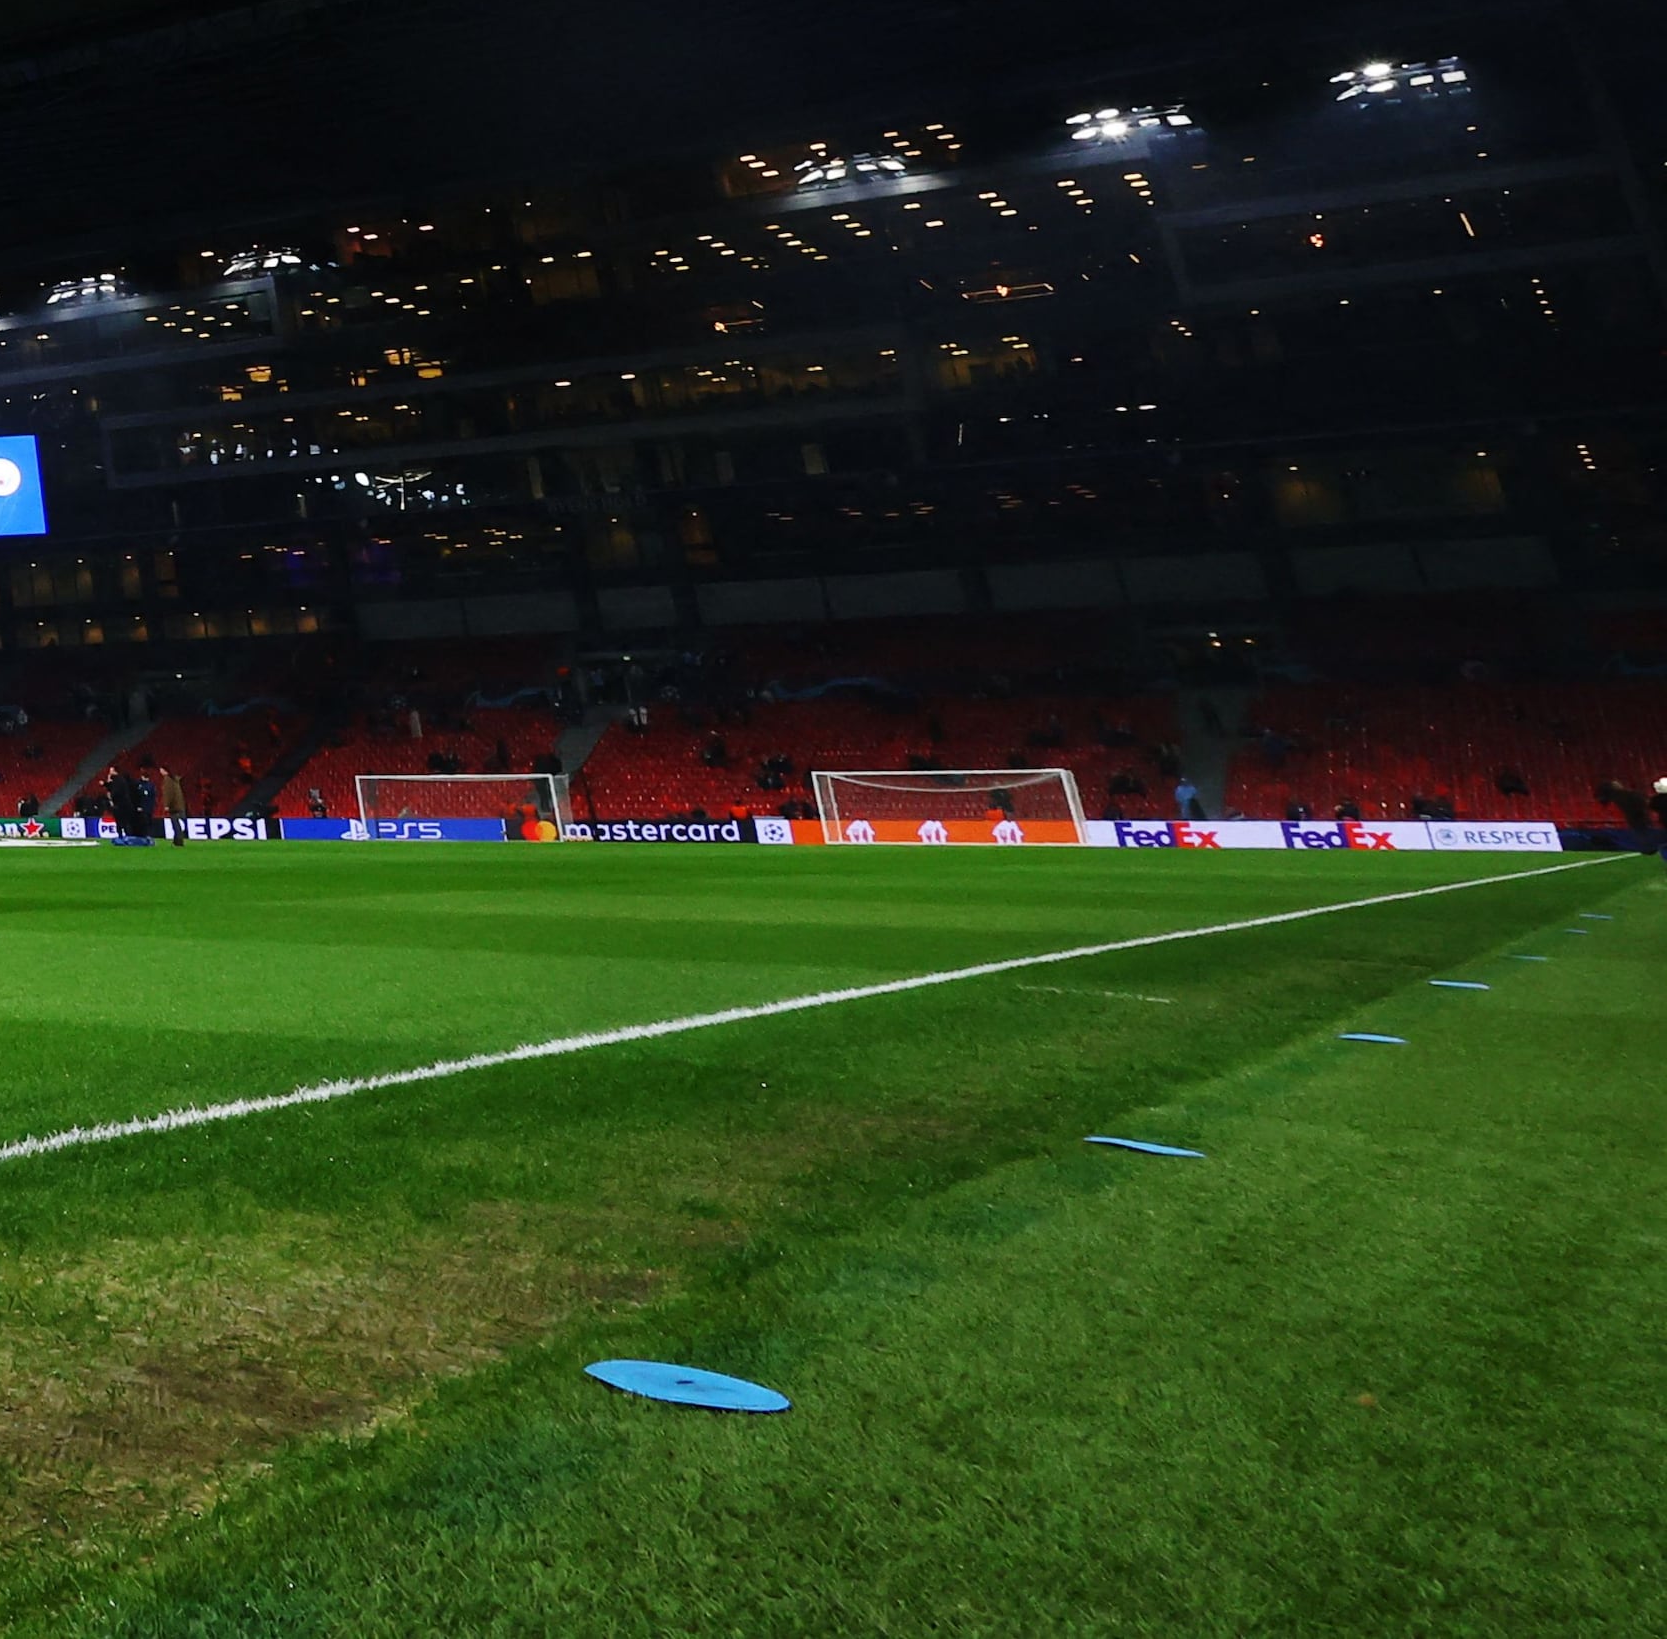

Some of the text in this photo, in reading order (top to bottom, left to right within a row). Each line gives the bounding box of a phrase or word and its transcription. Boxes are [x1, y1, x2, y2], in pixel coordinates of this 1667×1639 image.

[378, 822, 442, 839] PS5
[1115, 822, 1221, 849] FedEx
[1281, 822, 1395, 850] FedEx
[1464, 829, 1552, 846] RESPECT
